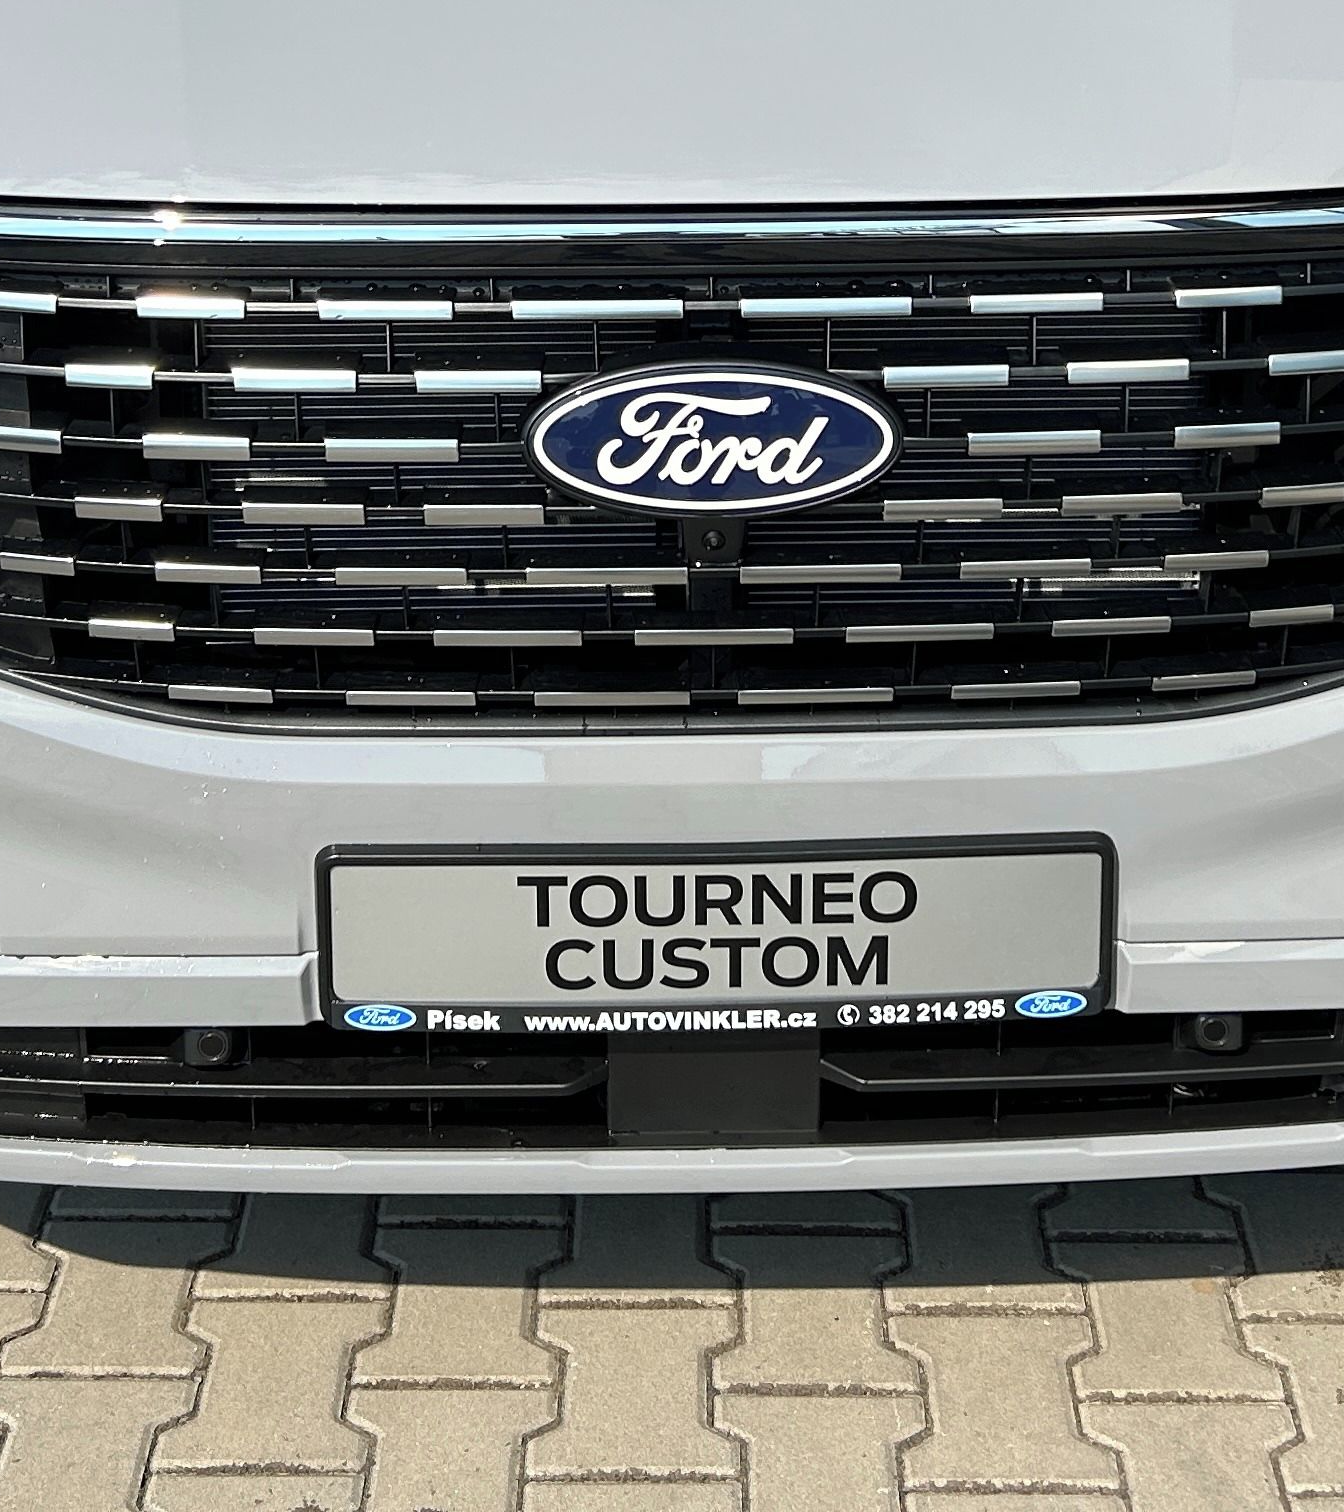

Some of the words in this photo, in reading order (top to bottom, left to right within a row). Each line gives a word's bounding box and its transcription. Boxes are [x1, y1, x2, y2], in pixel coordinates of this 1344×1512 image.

[597, 392, 830, 485] Ford
[517, 871, 918, 927] TOURNEO
[545, 935, 889, 990] CUSTOM
[427, 1010, 501, 1030] Písek
[524, 1008, 817, 1031] www.AUTOVINKLER.cz
[868, 1004, 909, 1024] 382
[916, 1001, 958, 1021] 214
[963, 999, 1006, 1019] 295
